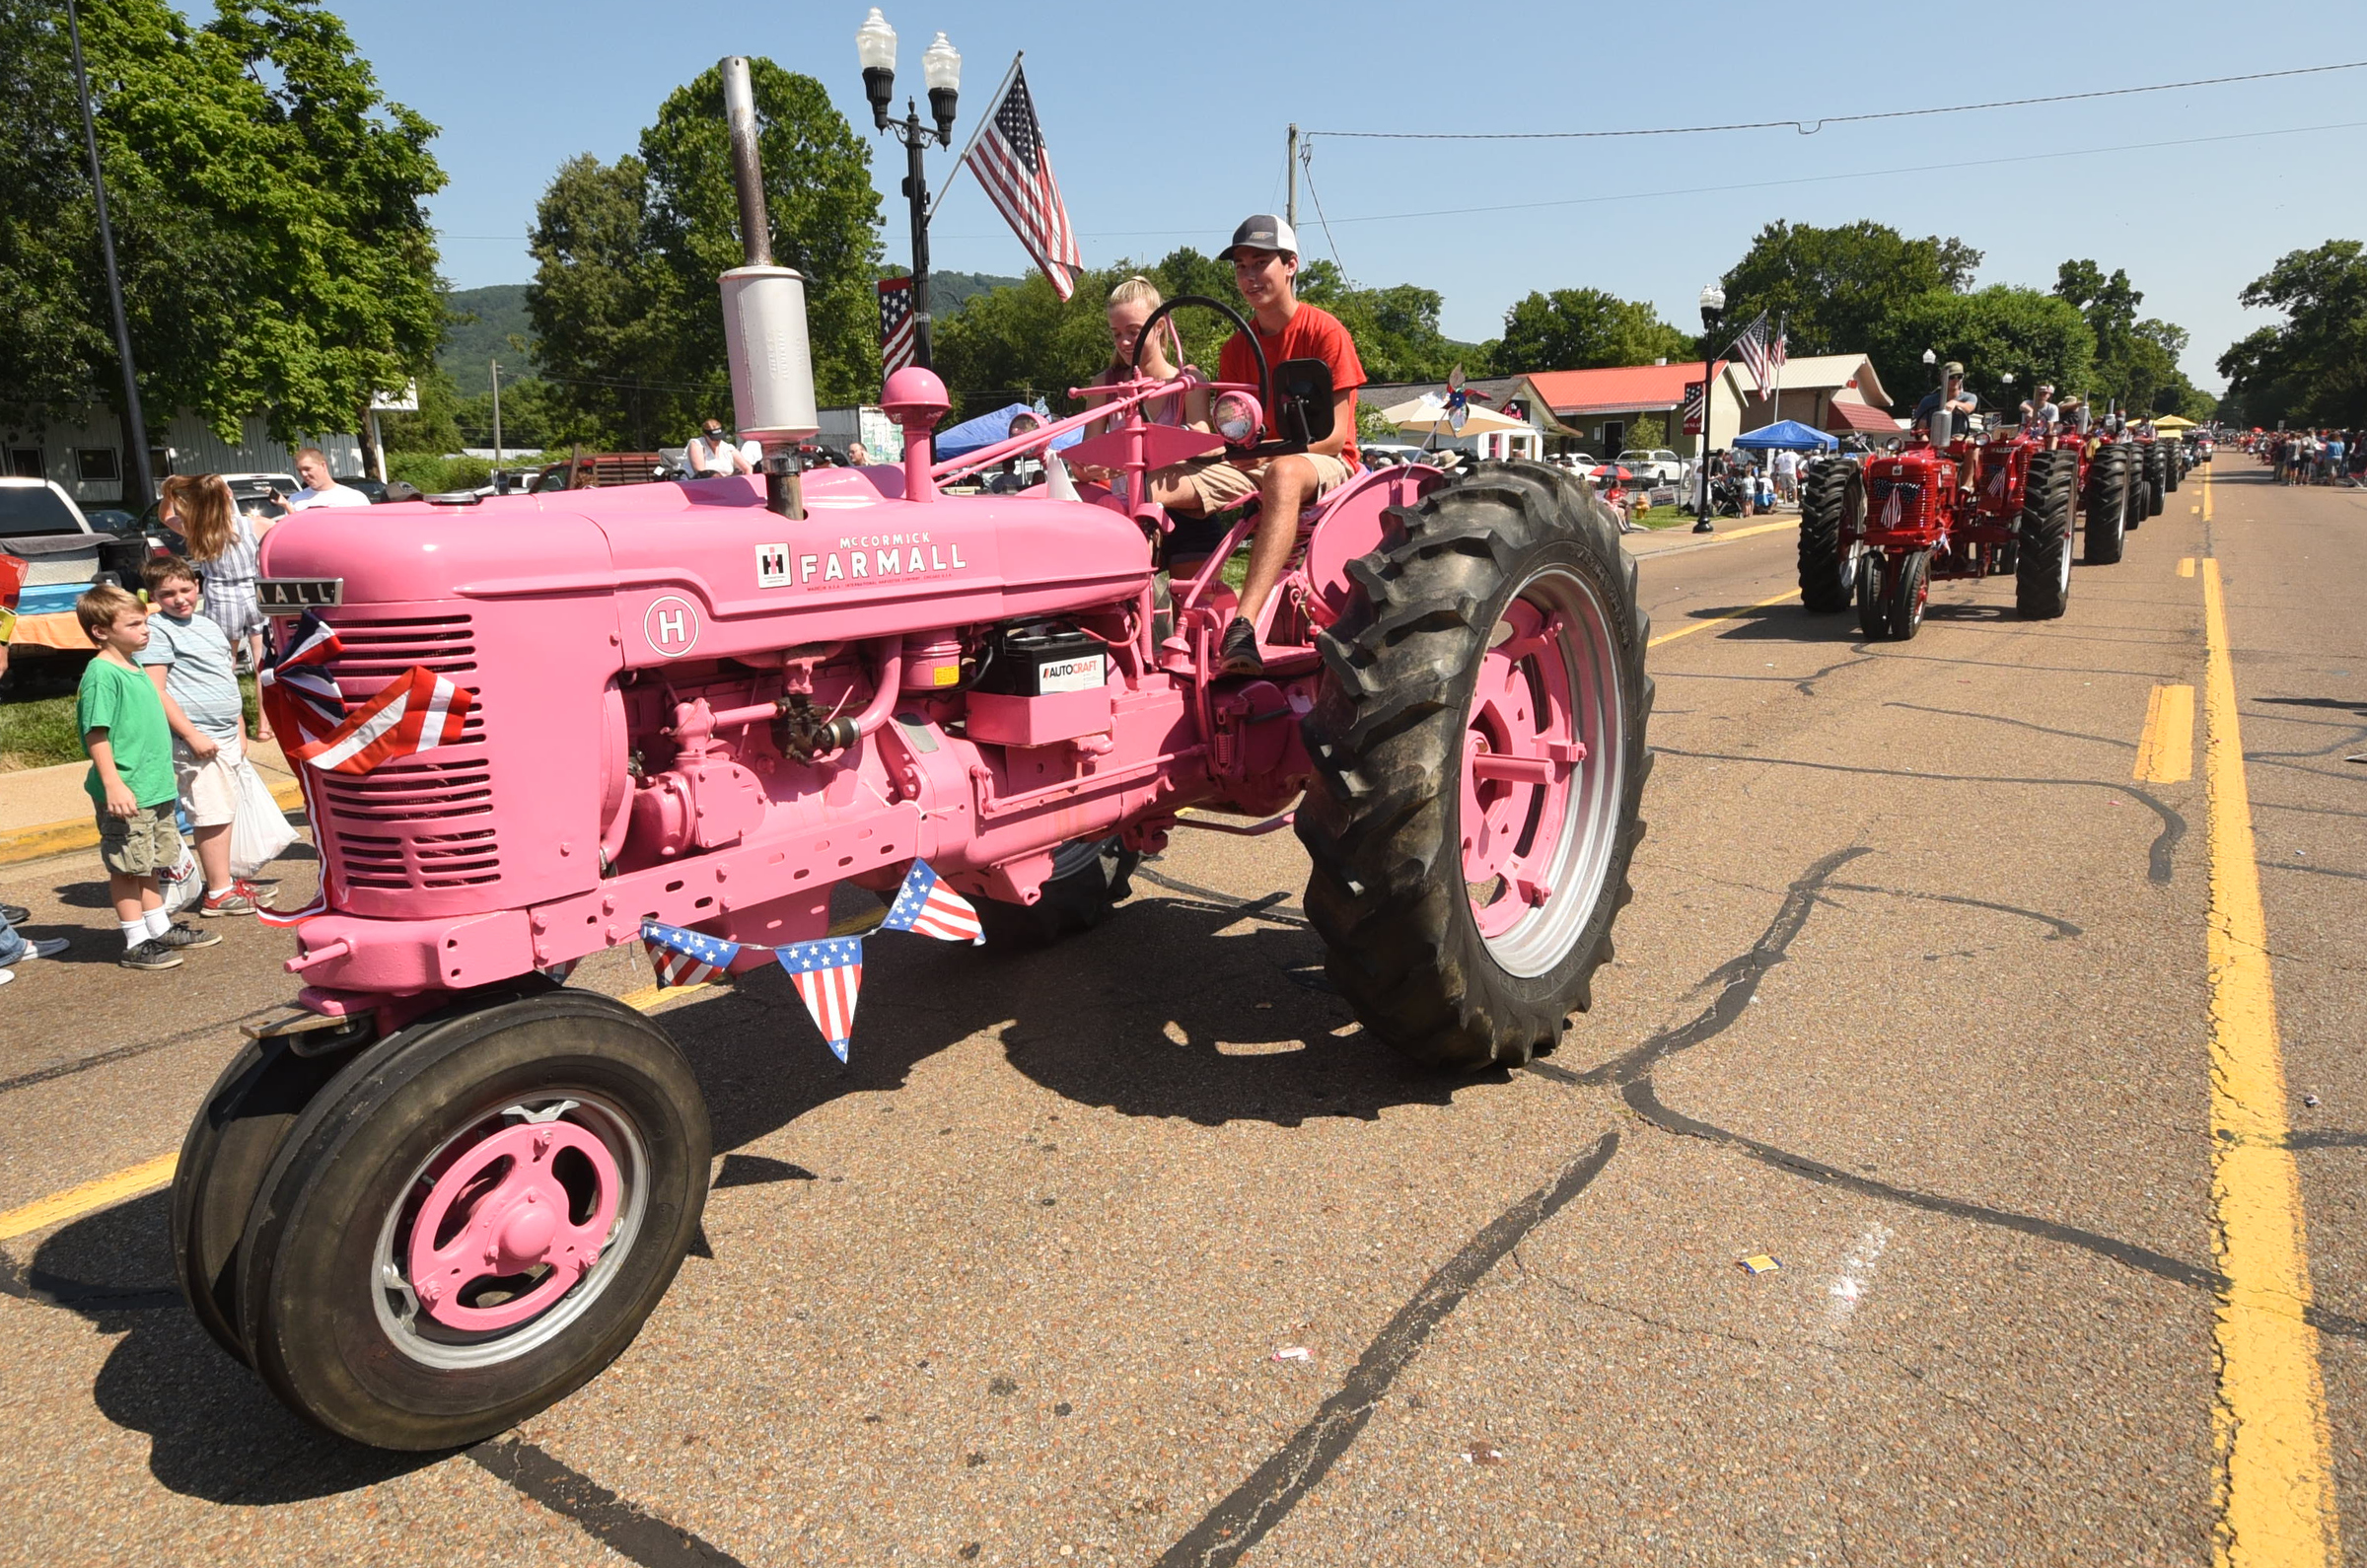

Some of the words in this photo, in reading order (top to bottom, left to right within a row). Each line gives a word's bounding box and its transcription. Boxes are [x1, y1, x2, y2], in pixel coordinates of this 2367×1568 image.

[800, 543, 968, 584] FARMALL
[657, 608, 686, 644] H
[1048, 660, 1097, 678] AUTOCRAFT
